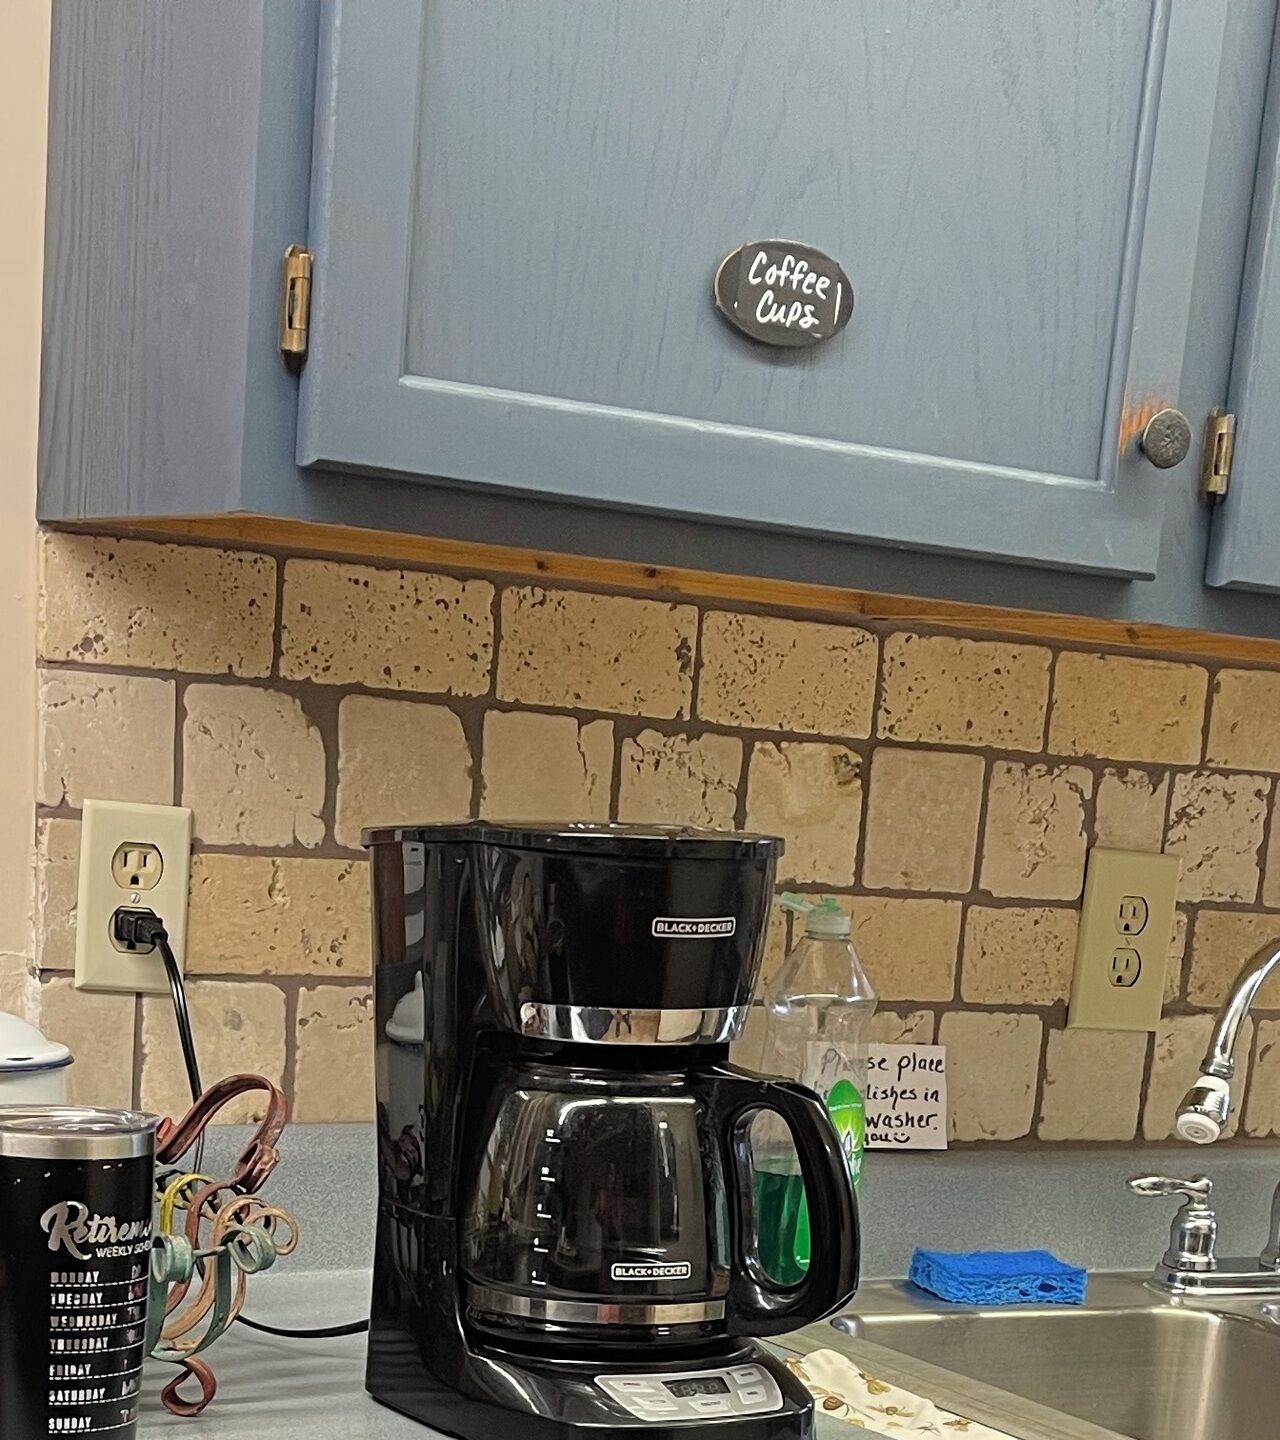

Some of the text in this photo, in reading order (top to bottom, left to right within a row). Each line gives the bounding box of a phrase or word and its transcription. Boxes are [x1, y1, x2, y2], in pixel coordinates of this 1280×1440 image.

[748, 251, 830, 300] Coffee
[756, 289, 819, 329] Cups
[897, 1052, 945, 1082] place
[924, 1088, 940, 1103] in
[96, 1244, 133, 1258] WEEKLY
[50, 1292, 103, 1306] TUESDAY
[49, 1363, 92, 1377] FRIDAY
[48, 1387, 106, 1402] SATURDAY
[48, 1416, 92, 1430] SUNDAY
